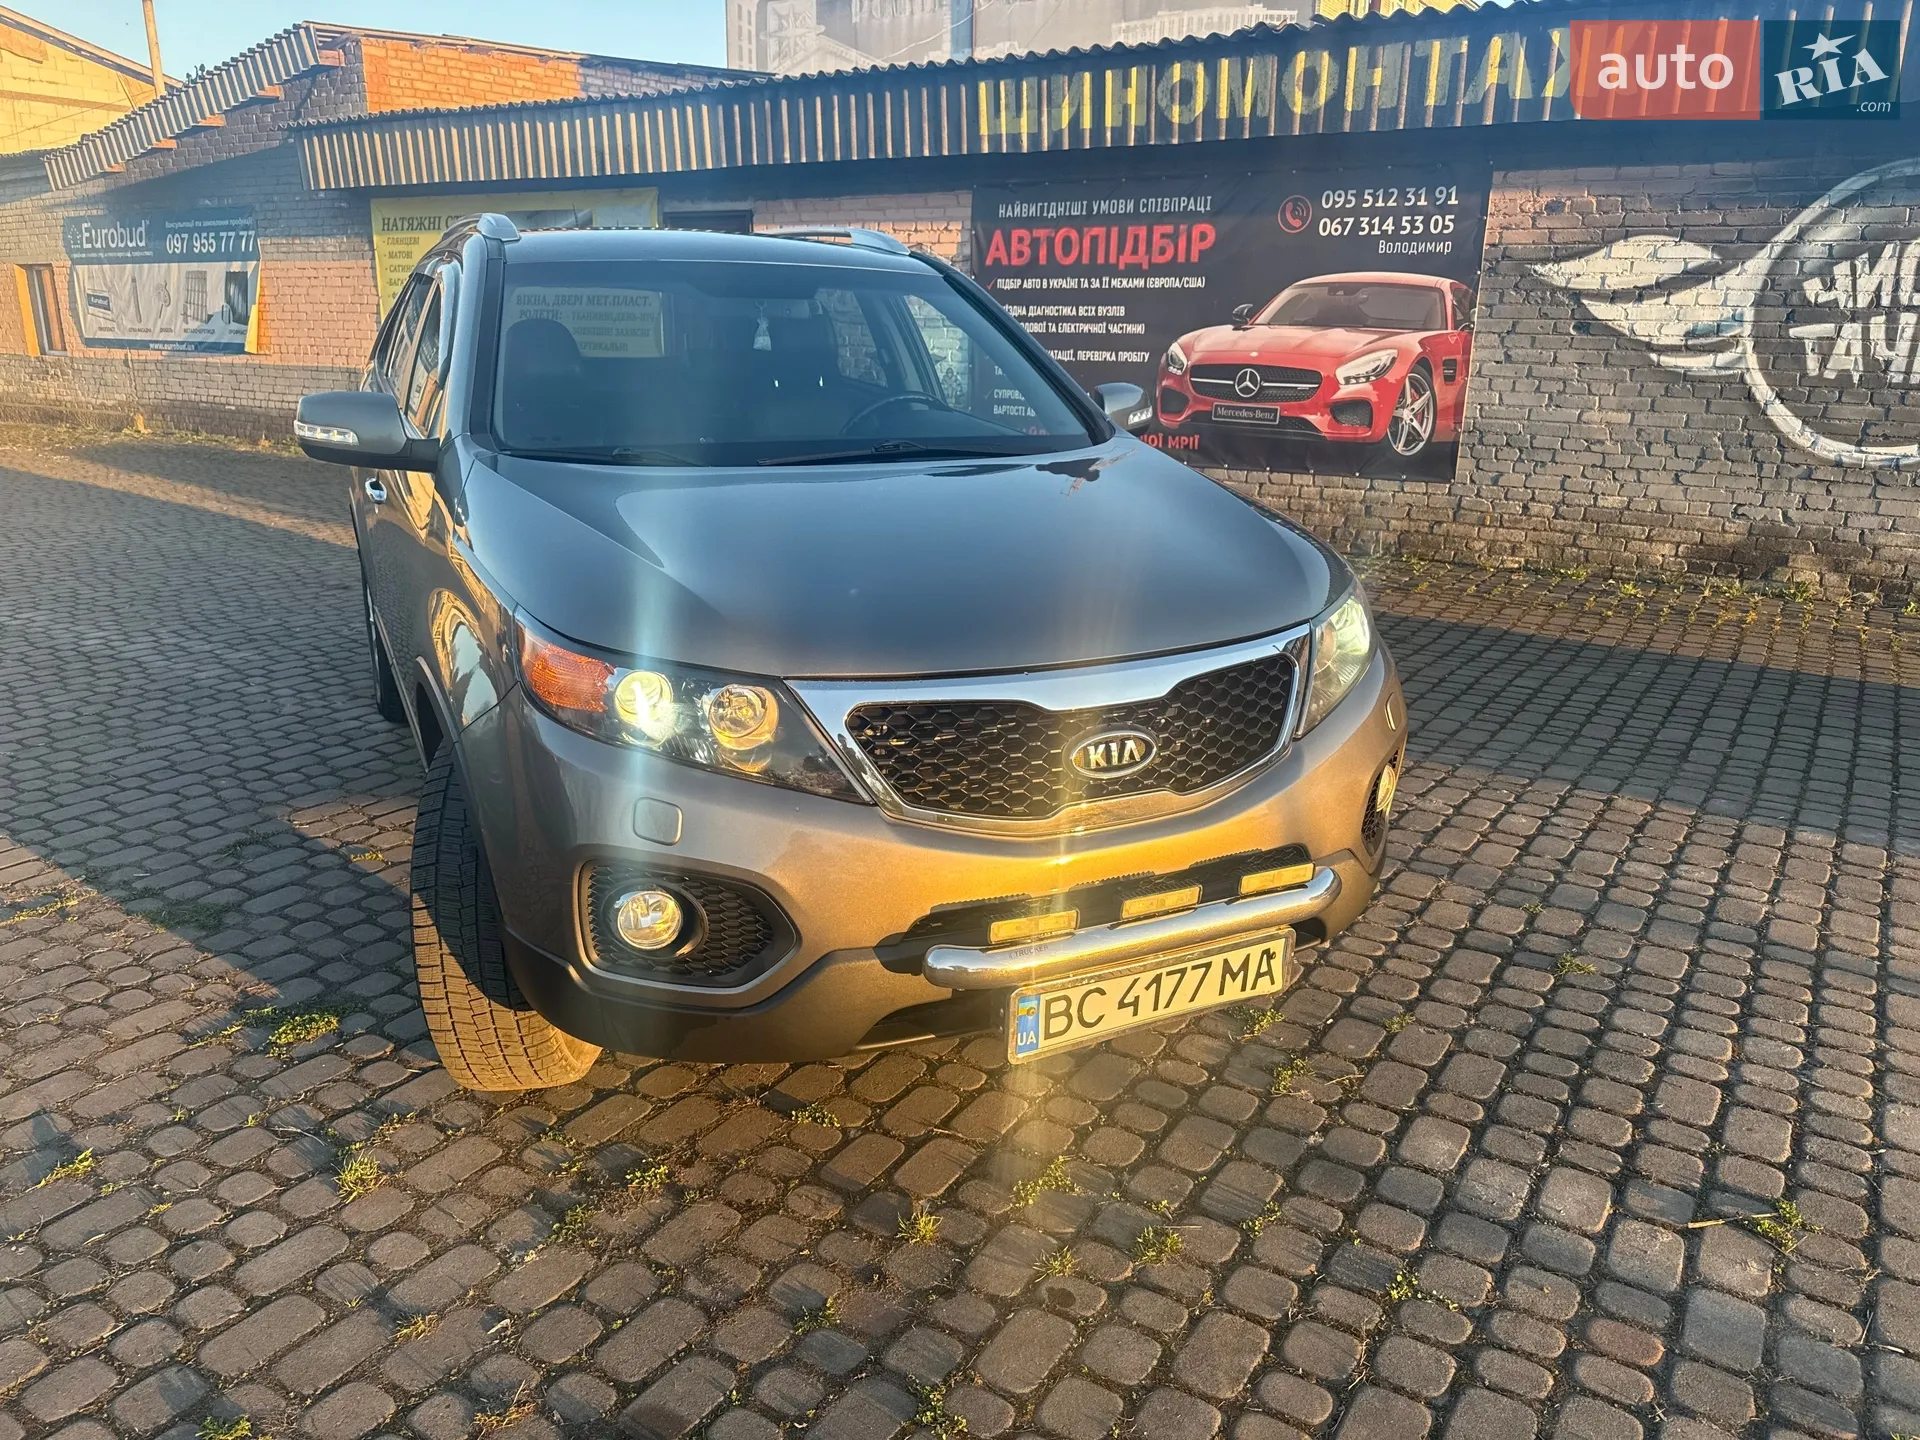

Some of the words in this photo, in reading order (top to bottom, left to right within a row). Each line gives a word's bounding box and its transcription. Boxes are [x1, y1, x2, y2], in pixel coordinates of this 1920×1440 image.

[1321, 189, 1357, 209] 095
[1362, 188, 1399, 208] 512
[1404, 187, 1428, 206] 31
[1434, 185, 1460, 206] 91
[998, 200, 1088, 219] НАЙВИГІДНІШІ
[1092, 198, 1135, 215] УМОВИ
[1139, 195, 1212, 213] СПІВПРАЦІ
[382, 216, 441, 232] НАТЯЖНІ
[1318, 217, 1355, 237] 067
[1358, 216, 1395, 236] 314
[1399, 216, 1424, 235] 53
[1429, 214, 1455, 235] 05
[82, 220, 146, 249] Eurobud
[166, 234, 189, 254] 097
[193, 233, 216, 253] 955
[220, 231, 236, 252] 77
[239, 230, 256, 251] 77
[984, 222, 1217, 270] АВТОПІДБІР
[1378, 240, 1452, 255] Володимир
[388, 250, 413, 260] МАТОВІ
[996, 277, 1022, 290] ПІДБІР
[1022, 278, 1041, 289] АВТО
[1042, 278, 1048, 289] В
[1049, 276, 1078, 289] УКРАЇНІ
[1080, 278, 1089, 288] ТА
[1090, 278, 1101, 288] ЗА
[1111, 277, 1145, 289] МЕЖАМИ
[1146, 276, 1206, 289] (ЄВРОПА/США)
[552, 294, 583, 307] ДВЕРІ
[1028, 304, 1077, 318] ДІАГНОСТИКА
[1078, 305, 1096, 317] ВСІХ
[1097, 305, 1126, 317] ВУЗЛІВ
[1048, 323, 1057, 333] ТА
[1058, 321, 1107, 334] ЕЛЕКТРИЧНОЇ
[1108, 323, 1145, 335] ЧАСТИНИ)
[1077, 350, 1117, 362] ПЕРЕВІРКА
[1117, 351, 1150, 363] ПРОБІГУ
[1216, 406, 1275, 420] Mercedes-Benz
[1168, 434, 1200, 450] МРІЇ
[1086, 739, 1141, 769] KIA
[1015, 944, 1049, 957] TRUCKER
[1043, 985, 1107, 1041] BC
[1116, 959, 1214, 1018] 4177
[1217, 947, 1276, 997] MA
[1017, 1032, 1037, 1047] UA
